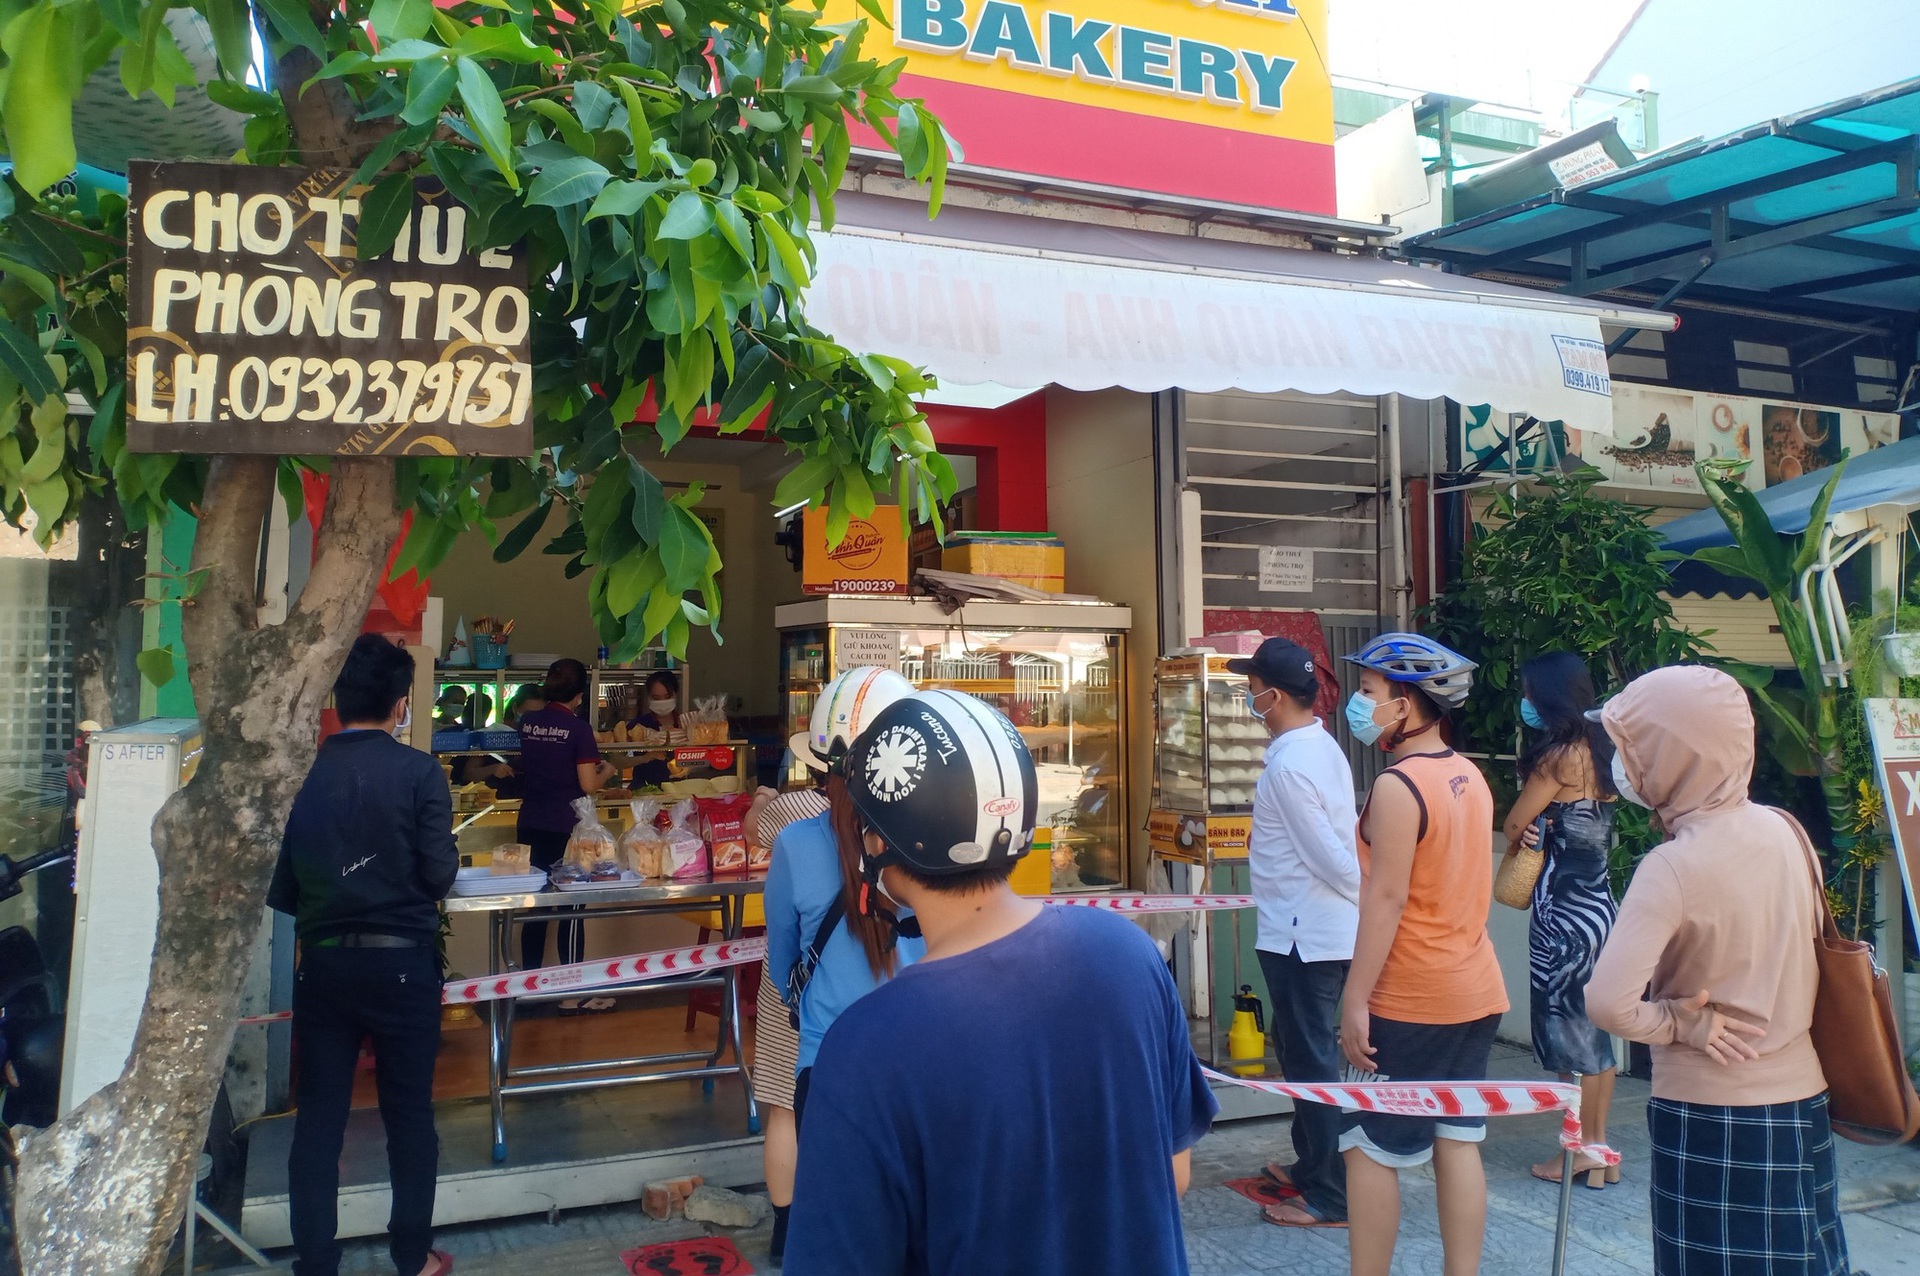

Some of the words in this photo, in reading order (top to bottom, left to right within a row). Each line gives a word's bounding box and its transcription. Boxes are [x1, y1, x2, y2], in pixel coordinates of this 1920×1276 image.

[896, 0, 1297, 112] BAKERY
[143, 190, 293, 255] CHO
[834, 580, 896, 592] 19000239
[875, 730, 889, 743] TO
[119, 744, 165, 760] AFTER
[677, 752, 706, 760] LOSHIP
[891, 725, 927, 772] DAMMTRAX
[865, 745, 876, 780] TAKE
[867, 781, 891, 802] MUST
[894, 782, 917, 801] YOU
